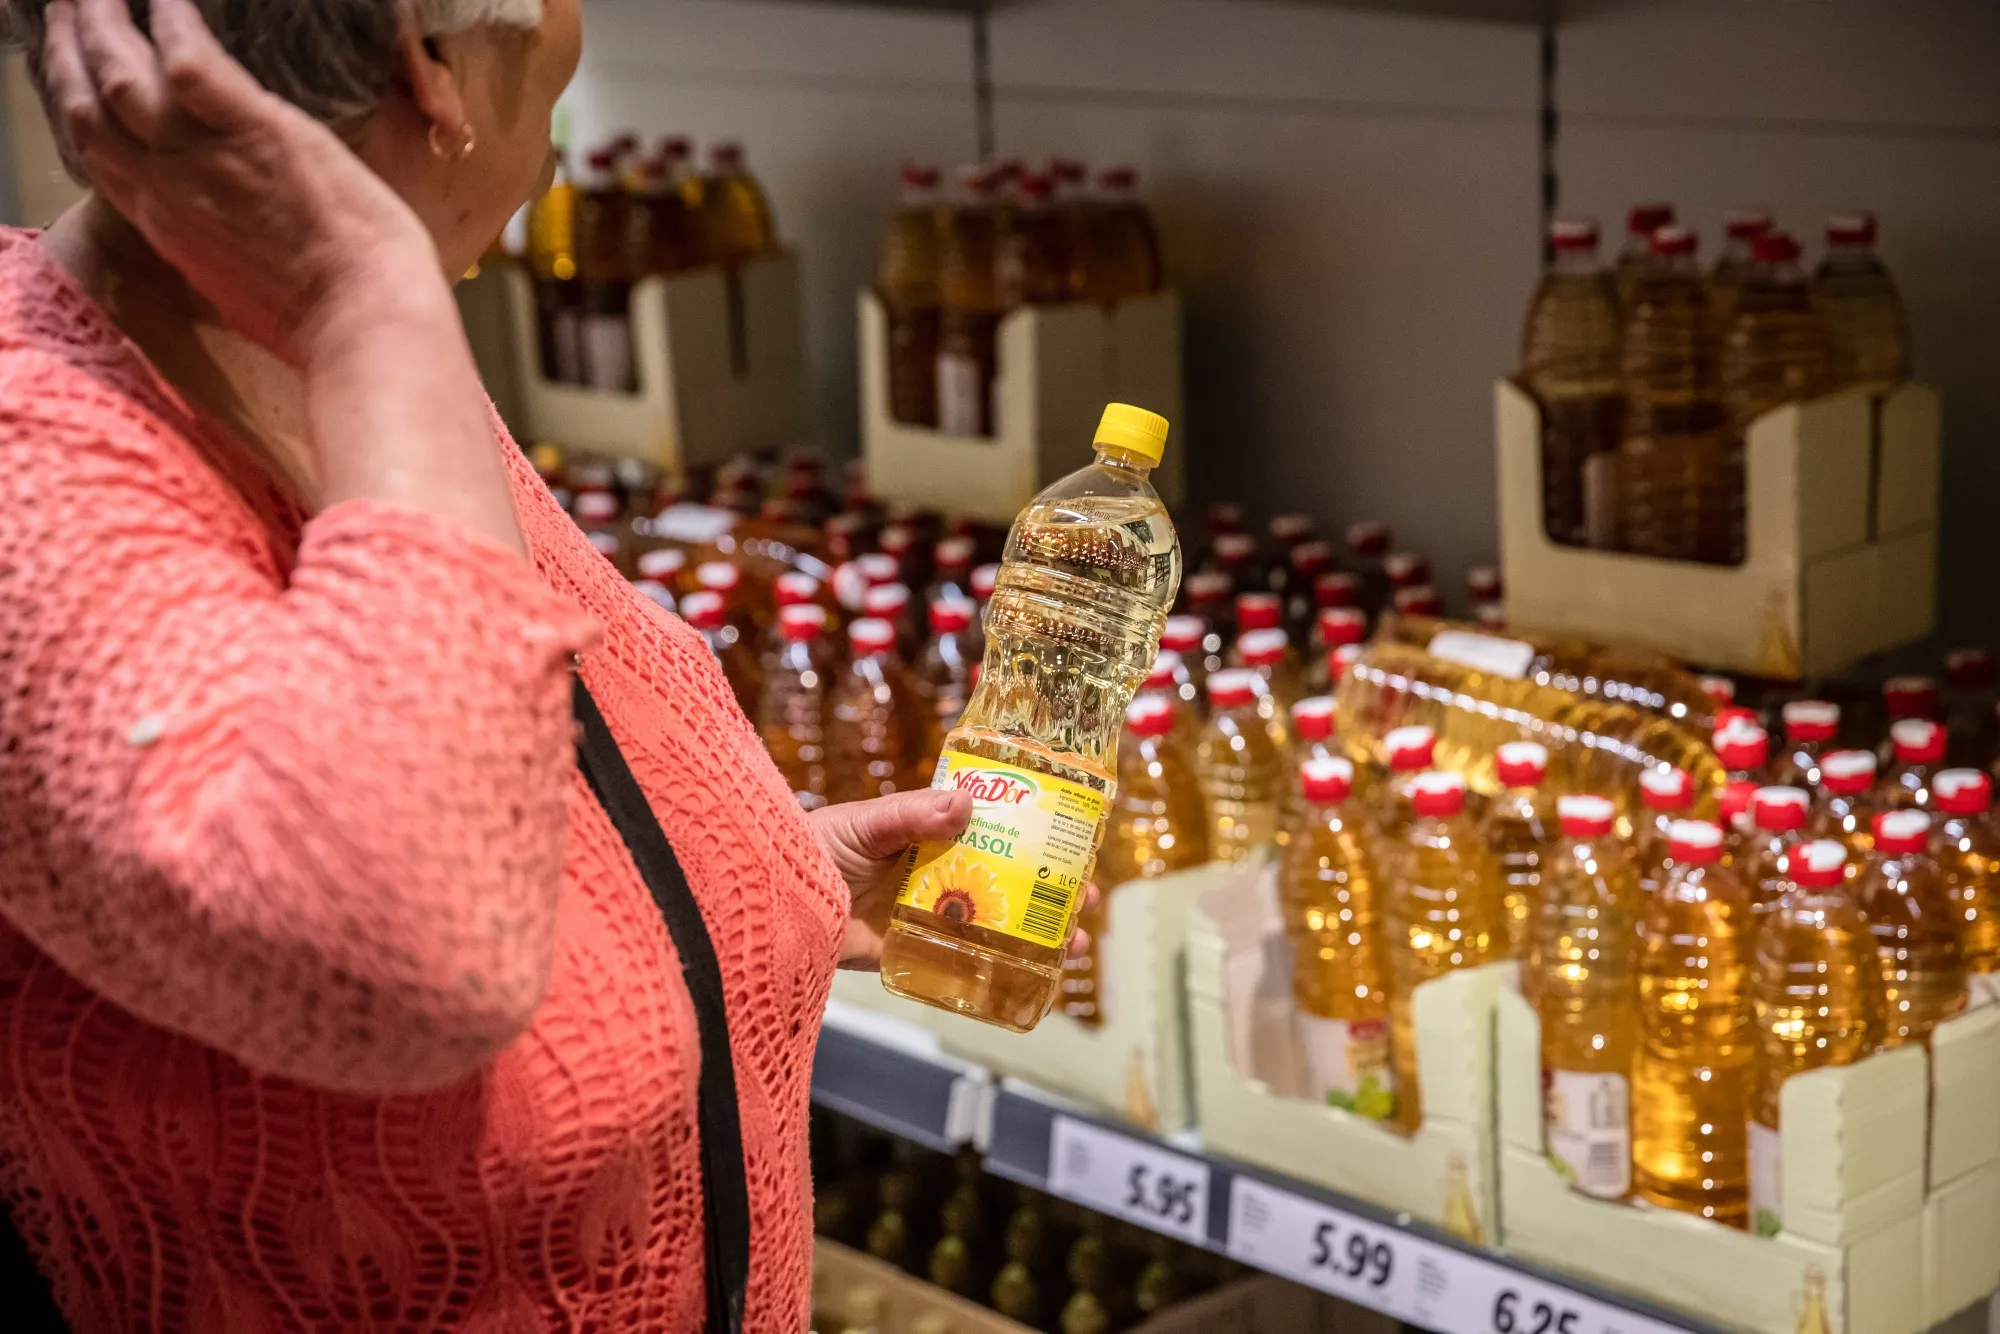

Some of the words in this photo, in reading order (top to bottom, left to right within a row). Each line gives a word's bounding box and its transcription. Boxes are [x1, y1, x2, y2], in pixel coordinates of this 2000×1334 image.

[1007, 826, 1020, 838] de
[1126, 1162, 1198, 1224] 5.95
[1310, 1222, 1394, 1286] 5.99
